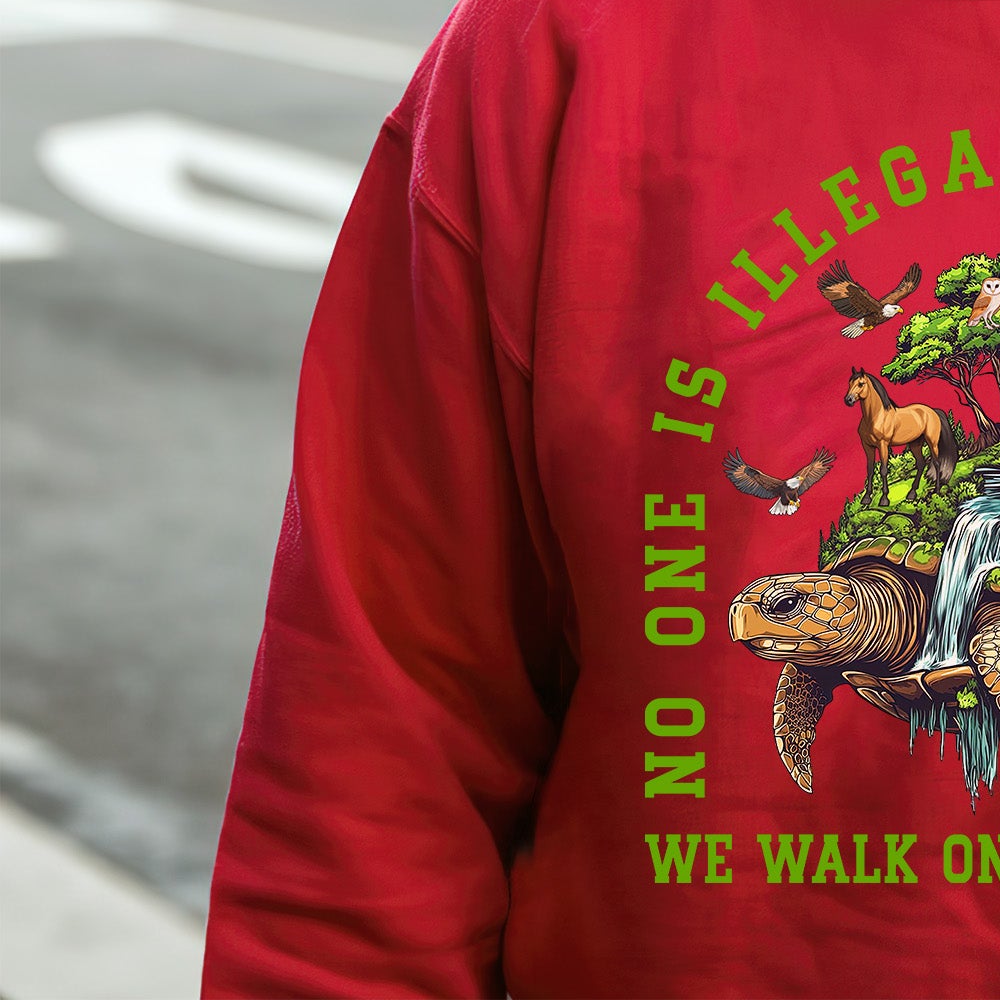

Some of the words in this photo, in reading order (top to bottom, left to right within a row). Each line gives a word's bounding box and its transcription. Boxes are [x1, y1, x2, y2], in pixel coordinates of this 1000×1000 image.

[652, 359, 727, 443] IS
[645, 494, 705, 646] ONE
[645, 697, 705, 799] NO
[645, 834, 733, 883] WE
[757, 834, 918, 883] WALK
